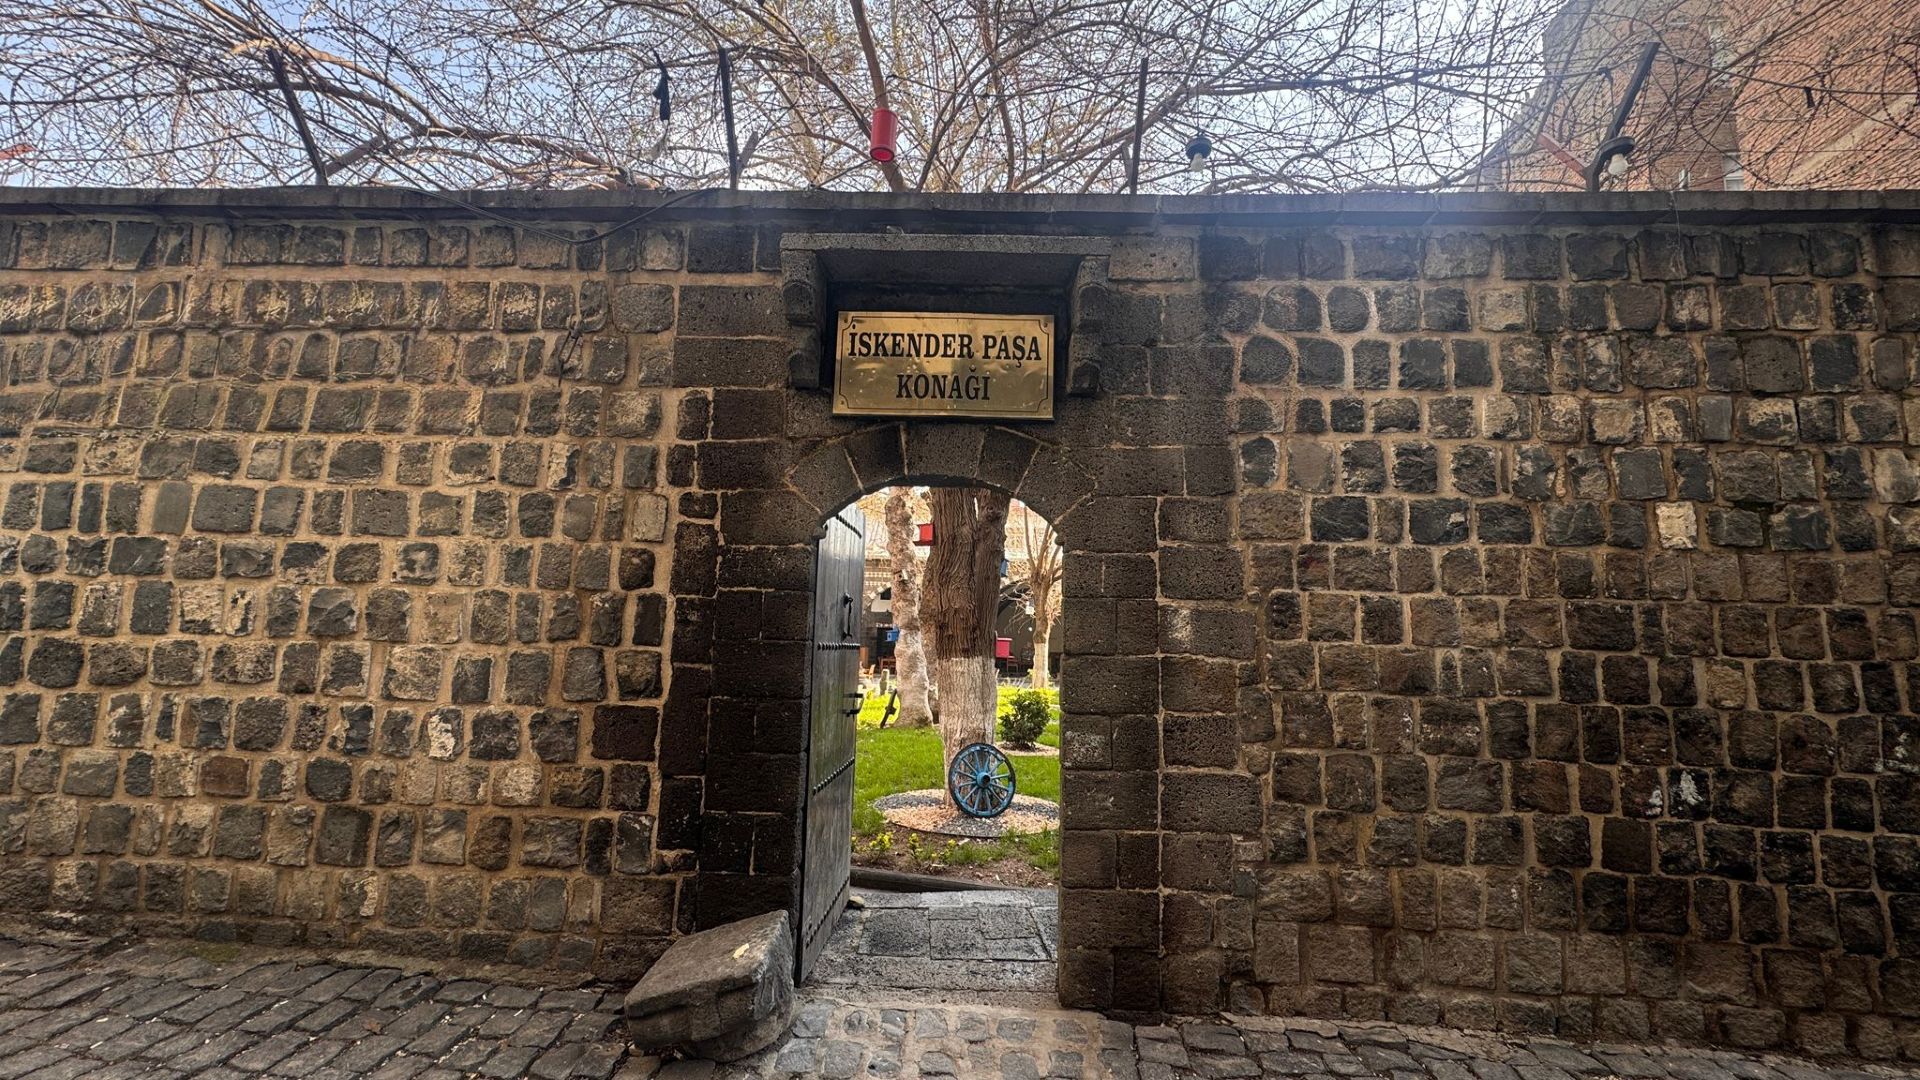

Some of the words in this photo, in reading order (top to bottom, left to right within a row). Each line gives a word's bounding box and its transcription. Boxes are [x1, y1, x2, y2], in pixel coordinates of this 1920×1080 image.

[848, 323, 975, 360] İSKENDER
[982, 334, 1042, 368] PAŞA
[896, 366, 990, 400] KONAĞI
